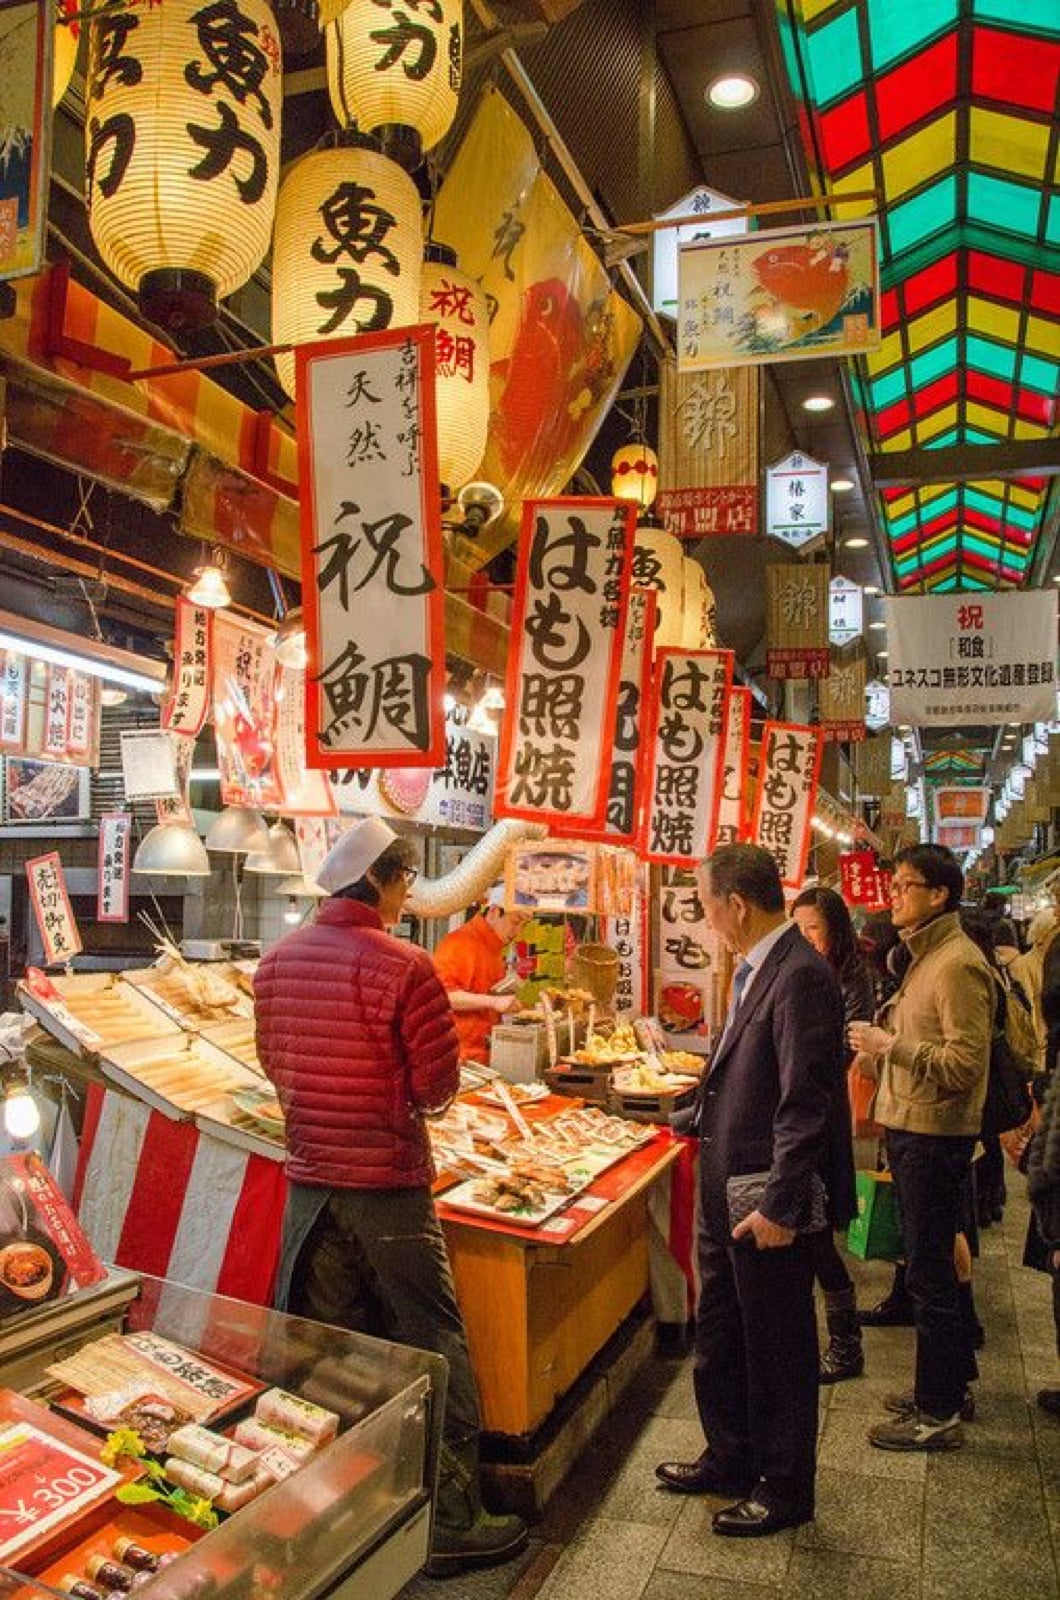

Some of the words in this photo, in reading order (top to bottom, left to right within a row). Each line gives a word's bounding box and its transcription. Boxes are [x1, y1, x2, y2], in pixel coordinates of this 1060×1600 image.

[366, 0, 443, 81] 力
[183, 0, 274, 204] 魚力
[311, 181, 401, 333] 魚力
[429, 279, 476, 384] 祝鯛
[345, 369, 388, 468] 天然
[395, 336, 422, 477] 吉祥を呼ぶ
[673, 376, 739, 459] 錦
[311, 501, 437, 754] 祝鯛
[511, 516, 602, 812] はも照焼
[958, 605, 984, 630] 祝
[892, 661, 1055, 688] ユネスコ無形文化遺産登録
[651, 659, 711, 855] はも照焼
[662, 889, 711, 969] はも
